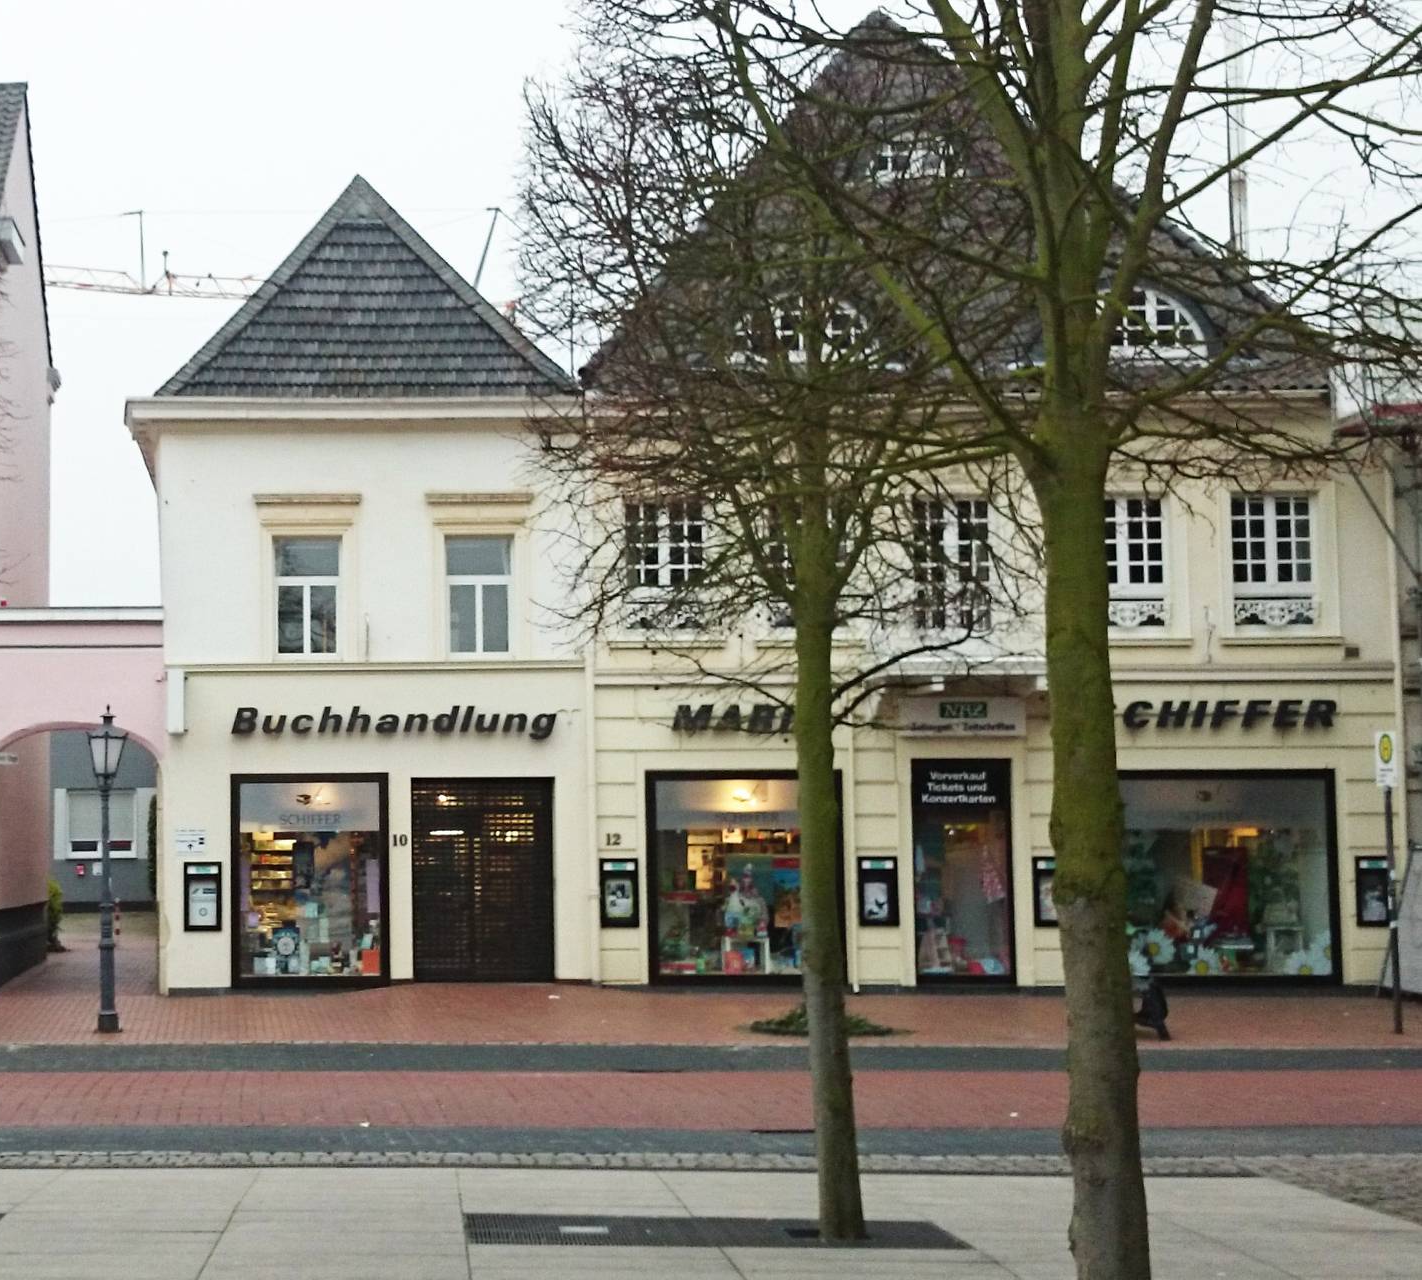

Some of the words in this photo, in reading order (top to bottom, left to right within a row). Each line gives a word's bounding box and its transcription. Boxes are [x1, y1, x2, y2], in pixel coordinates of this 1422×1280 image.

[1114, 700, 1338, 729] CHIFFER
[231, 705, 558, 740] Buchhandlung
[929, 771, 986, 780] Vorverkauf
[927, 782, 965, 792] Tickets
[966, 782, 987, 792] und
[921, 794, 996, 804] Konzertkarten
[280, 813, 342, 825] SCHIFFER
[393, 834, 408, 846] 10
[605, 833, 622, 846] 12
